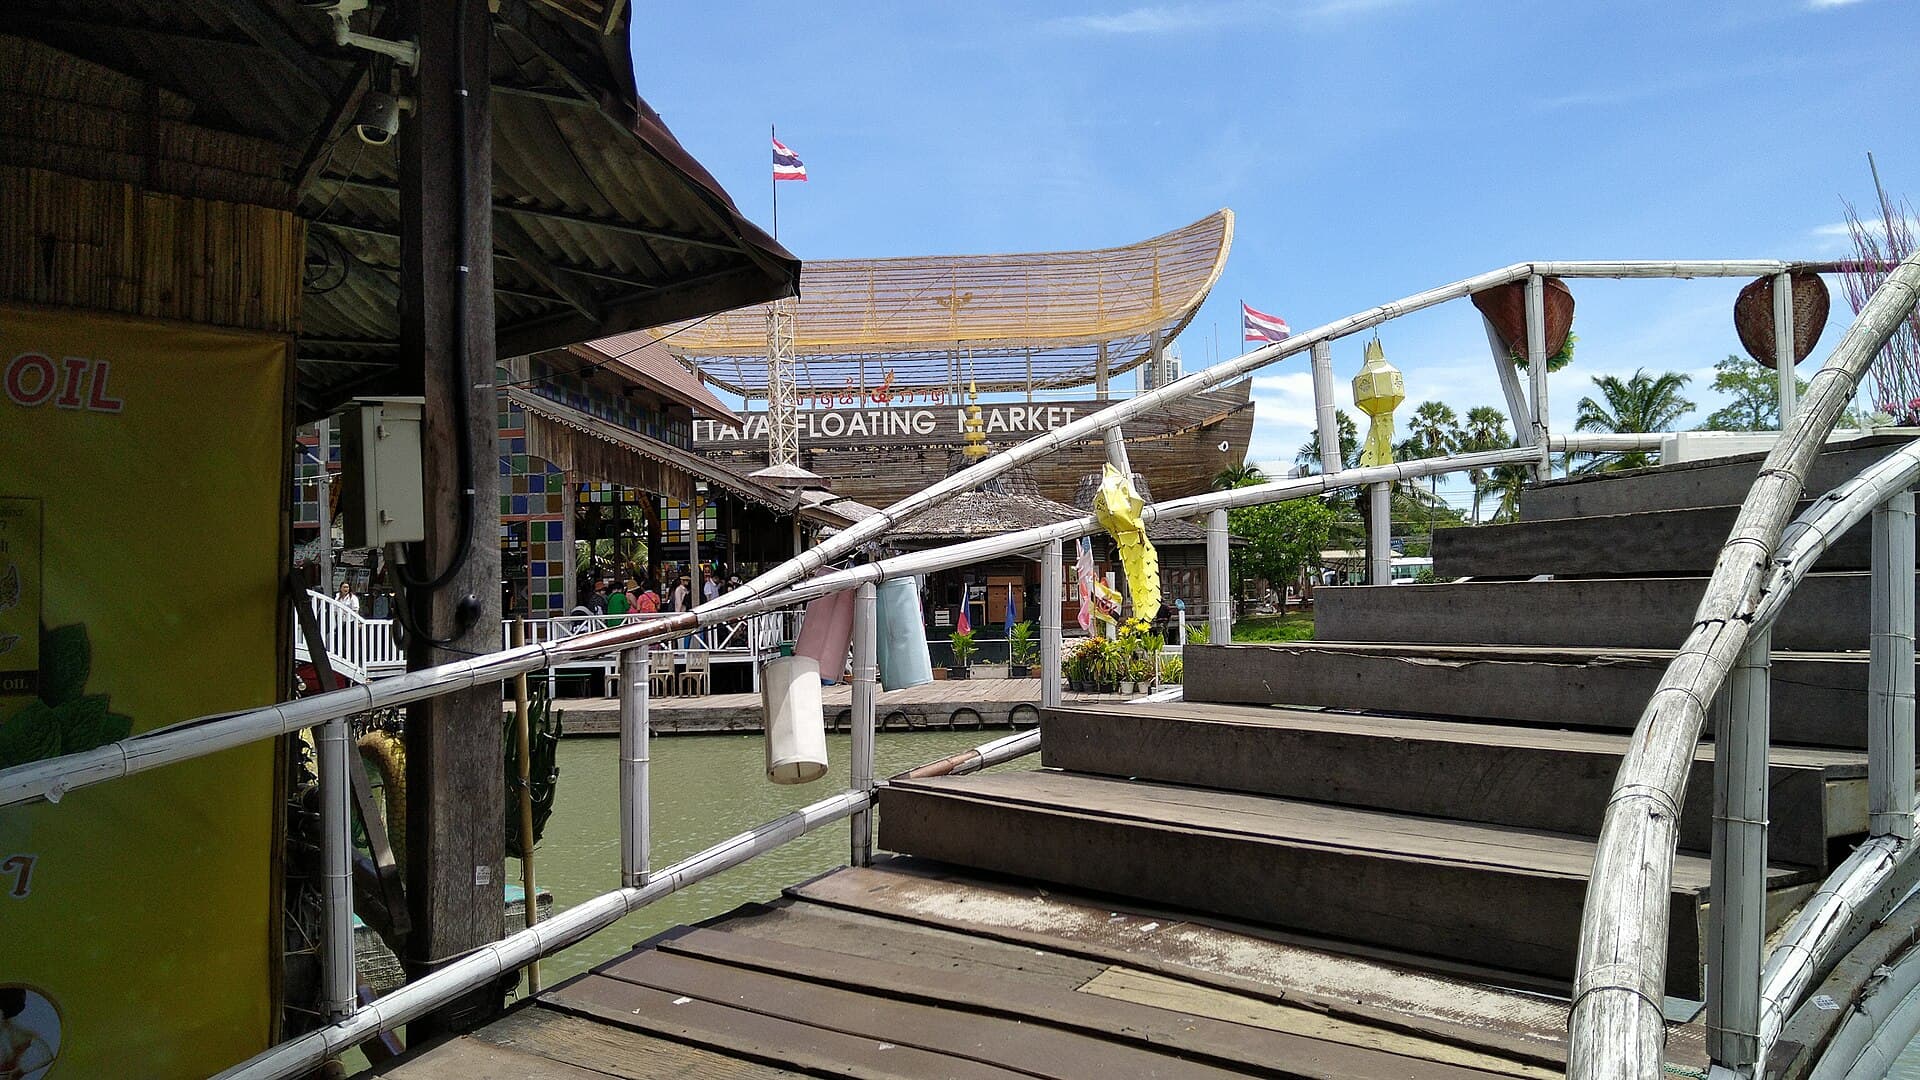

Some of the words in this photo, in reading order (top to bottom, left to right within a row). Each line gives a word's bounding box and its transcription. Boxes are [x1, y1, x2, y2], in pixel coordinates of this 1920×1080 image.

[4, 352, 124, 414] OIL
[796, 410, 937, 438] FLOATING
[957, 405, 1075, 434] MARKET
